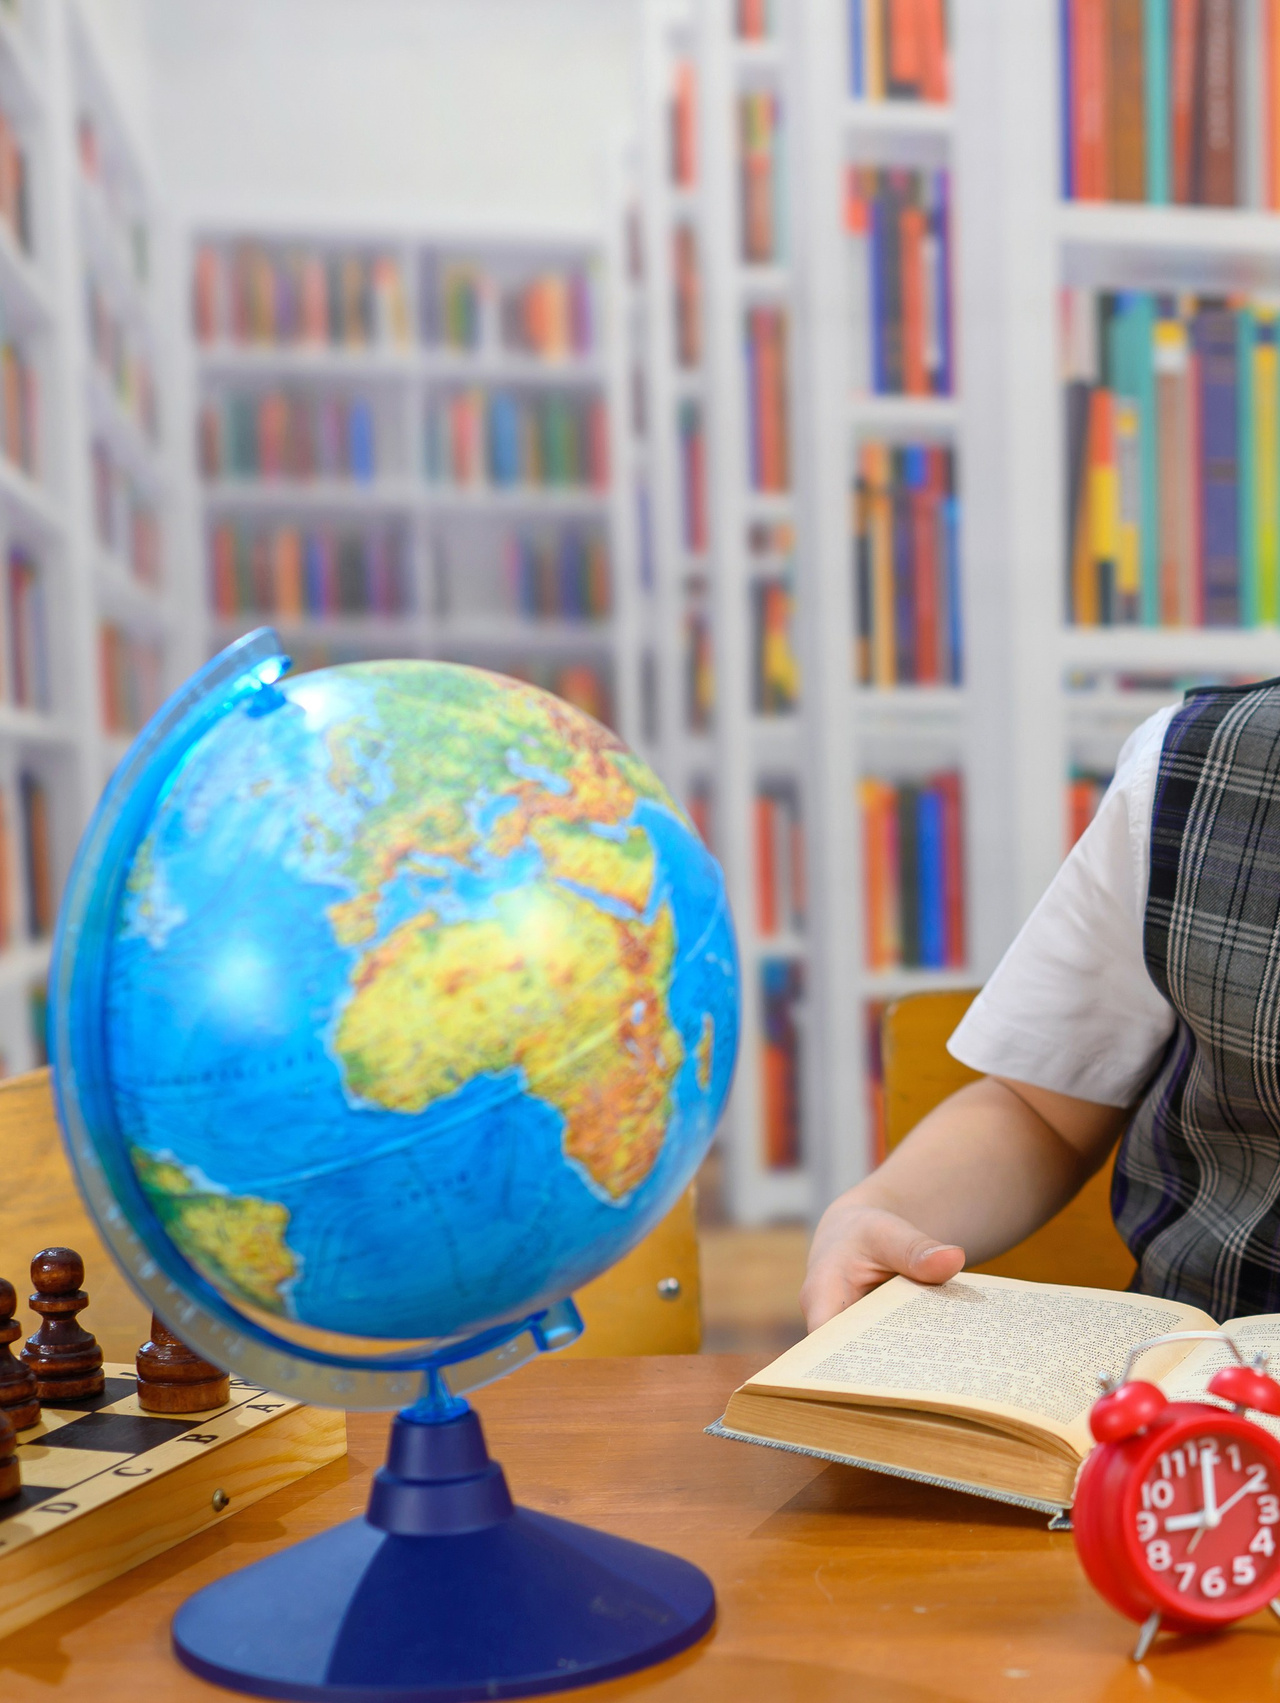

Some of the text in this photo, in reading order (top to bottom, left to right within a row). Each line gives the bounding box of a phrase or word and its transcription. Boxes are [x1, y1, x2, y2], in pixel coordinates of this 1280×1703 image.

[246, 1403, 286, 1413] A
[176, 1433, 219, 1445] B
[1184, 1437, 1220, 1467] 12
[112, 1466, 153, 1477] C
[1158, 1450, 1186, 1479] 11
[1226, 1444, 1241, 1473] 1
[1246, 1464, 1269, 1493] 2
[32, 1502, 79, 1516] D
[1141, 1479, 1175, 1510] 10
[1257, 1494, 1280, 1525] 3
[1136, 1511, 1158, 1542] 9
[1249, 1526, 1275, 1557] 4
[1146, 1539, 1172, 1571] 8
[1232, 1555, 1256, 1585] 5
[1174, 1562, 1196, 1592] 7
[1201, 1566, 1227, 1598] 6
